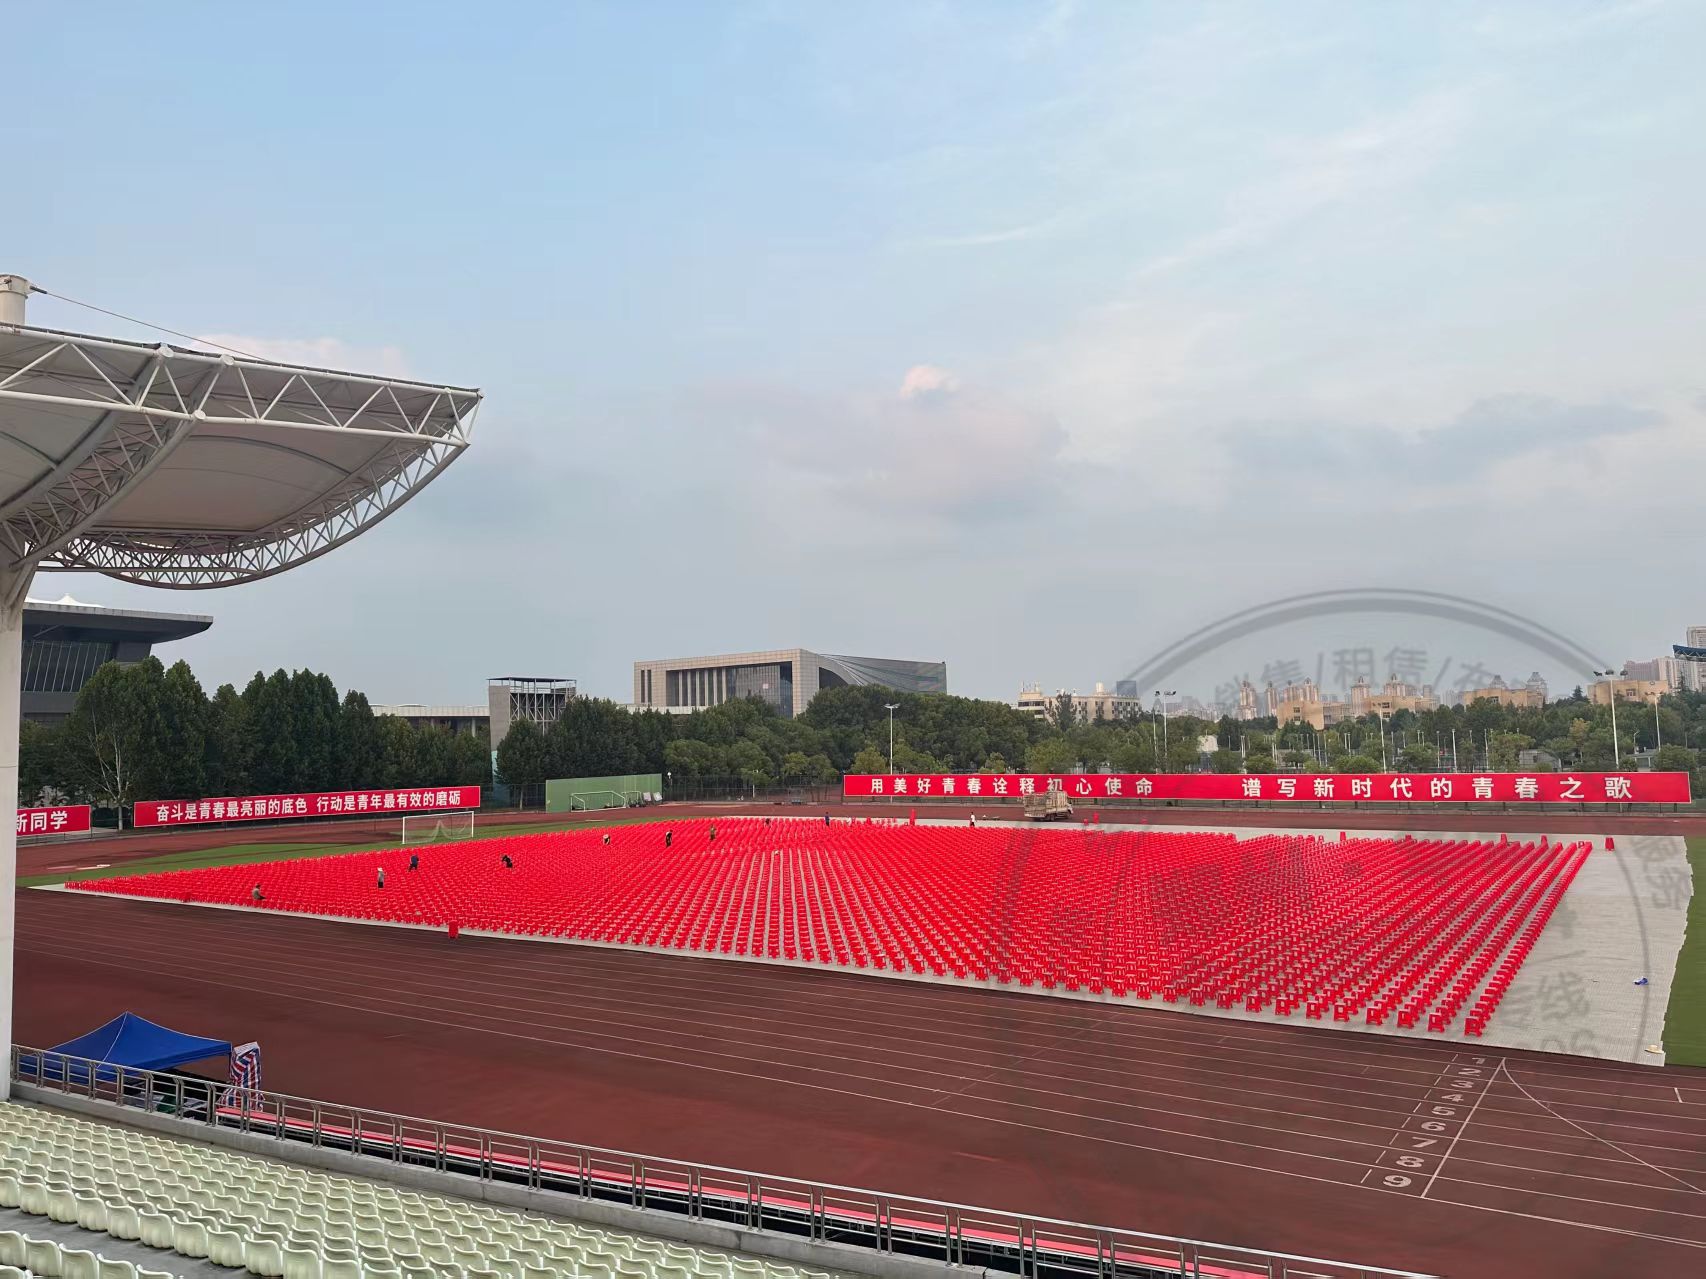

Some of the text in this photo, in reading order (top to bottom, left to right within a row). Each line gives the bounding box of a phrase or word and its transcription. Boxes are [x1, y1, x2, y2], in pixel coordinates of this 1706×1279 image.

[870, 776, 1633, 800] 用美好青春诠释初心使命 谱写新时代的青春之歌
[156, 790, 462, 822] 奋斗是青春最亮丽的底色 行动是青年最有效的磨砺
[1458, 1068, 1482, 1077] 2
[1451, 1080, 1475, 1089] 3
[1441, 1093, 1465, 1103] 4
[1431, 1106, 1456, 1116] 5
[1421, 1121, 1446, 1132] 6
[1411, 1136, 1439, 1148] 7
[1395, 1155, 1425, 1168] 8
[1382, 1175, 1412, 1188] 9
